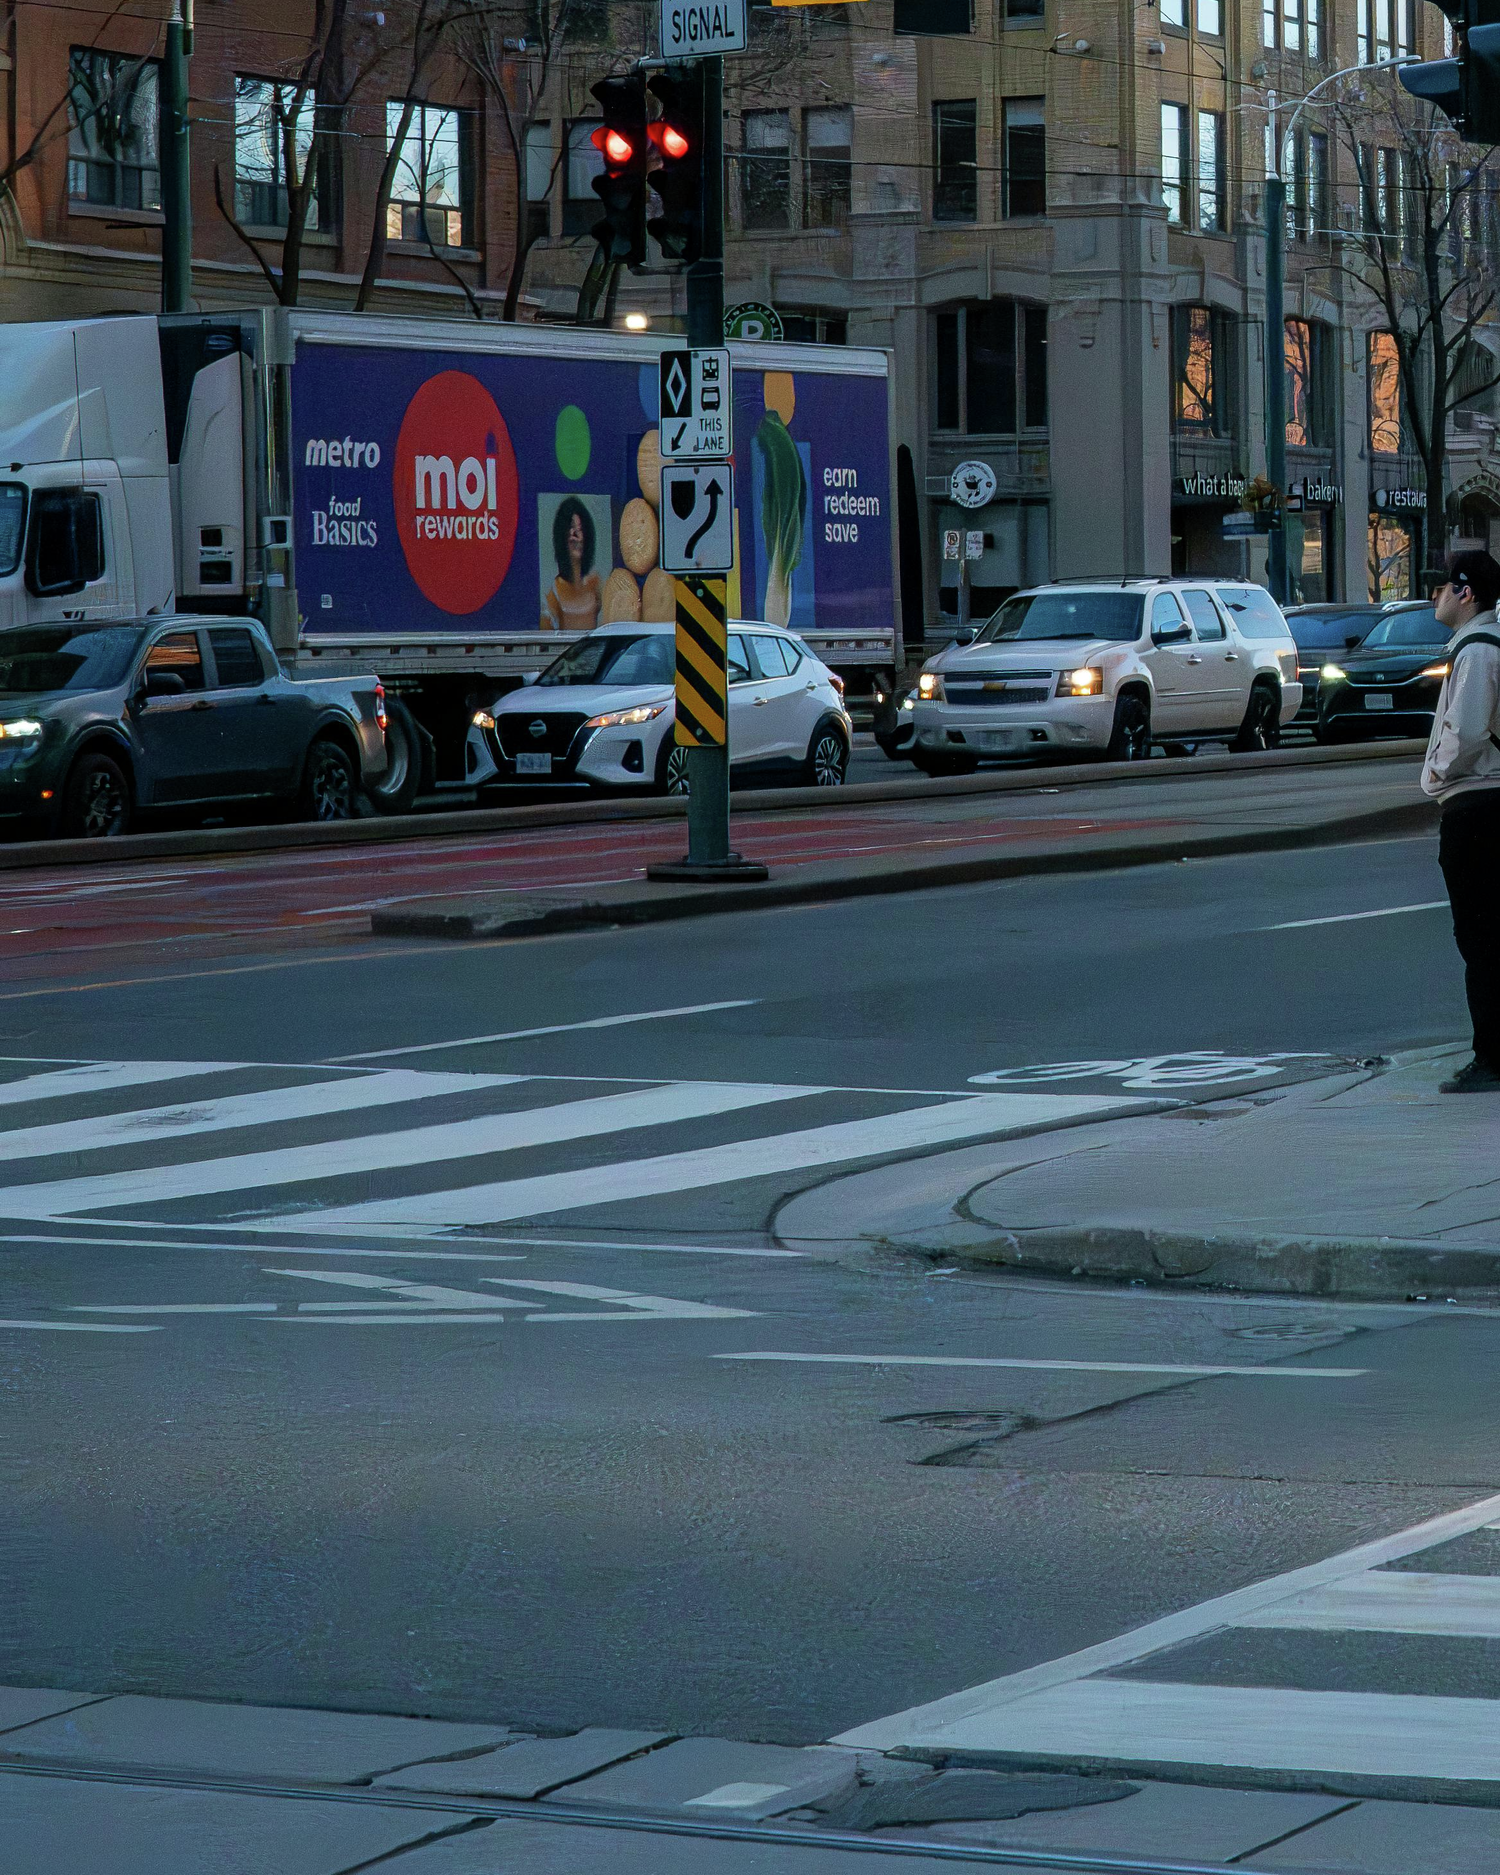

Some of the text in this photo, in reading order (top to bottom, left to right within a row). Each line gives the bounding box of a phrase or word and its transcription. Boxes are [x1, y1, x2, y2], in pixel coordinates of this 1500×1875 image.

[672, 4, 735, 44] SIGNAL
[699, 418, 722, 432] THIS
[305, 435, 381, 468] metro
[697, 436, 725, 451] LANE
[415, 430, 498, 511] moi
[824, 467, 858, 488] earn
[1183, 470, 1219, 496] what
[1220, 478, 1227, 496] a
[329, 496, 361, 516] food
[824, 491, 880, 516] redeem
[312, 510, 378, 547] Basics
[416, 511, 499, 540] rewards
[825, 523, 859, 543] save
